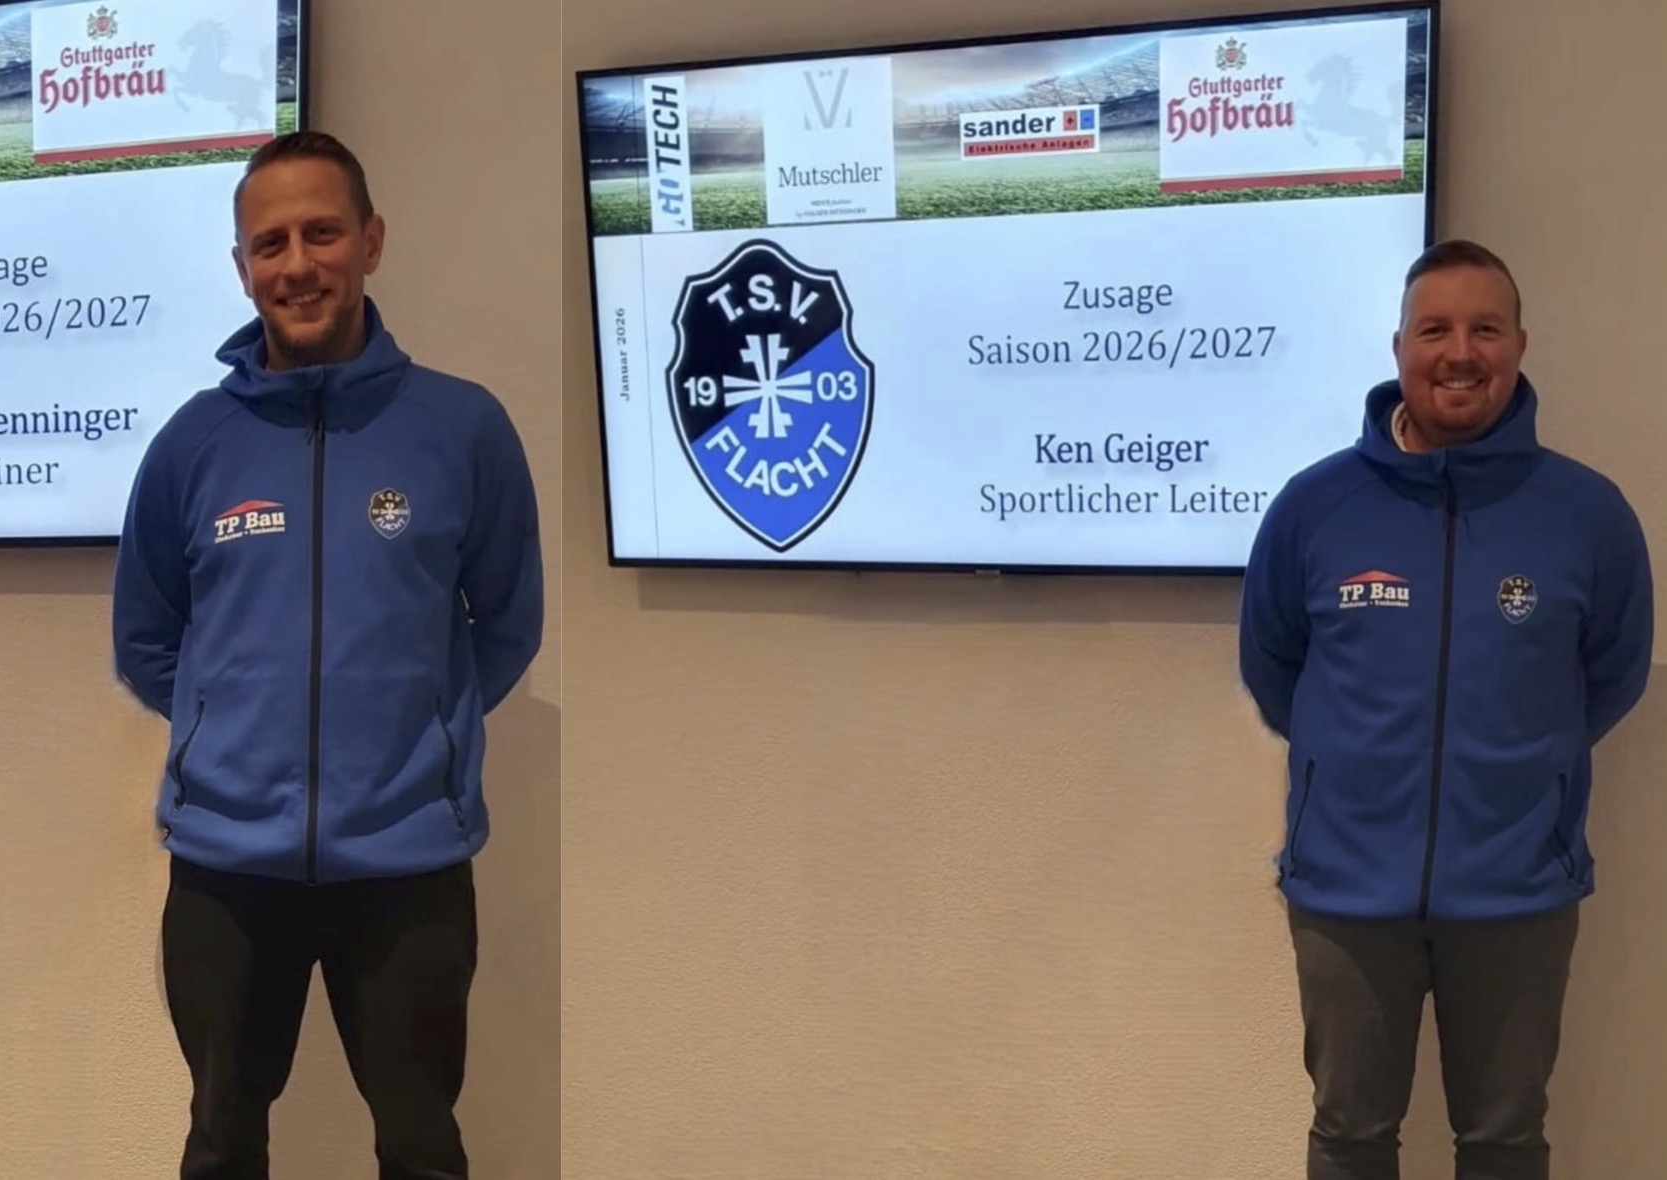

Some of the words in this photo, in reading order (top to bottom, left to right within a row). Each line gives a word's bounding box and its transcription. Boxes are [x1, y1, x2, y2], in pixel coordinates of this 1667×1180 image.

[60, 42, 155, 69] Stuttgarter
[39, 61, 165, 113] Hofbräu
[1188, 74, 1285, 98] Stuttgarter
[963, 113, 1055, 138] sander
[1166, 93, 1293, 142] Hofbräu
[968, 142, 1036, 154] Elektrische
[1042, 139, 1090, 149] Anlagen
[778, 163, 883, 188] Mutschler
[707, 274, 819, 324] T.S.V.
[1063, 281, 1173, 314] Zusage
[616, 308, 626, 345] 2026
[968, 335, 1072, 365] Saison
[1083, 325, 1276, 369] 2026/2027
[619, 350, 630, 401] Januar
[684, 376, 717, 406] 19
[816, 371, 858, 401] 03
[705, 422, 846, 497] FLACHT
[1034, 433, 1094, 463] Ken
[1104, 433, 1209, 472] Geiger
[980, 483, 1159, 521] Sportlicher
[1169, 483, 1268, 513] Leiter
[215, 516, 240, 536] TP
[245, 511, 285, 529] Bau
[1339, 584, 1364, 601] TP
[1370, 583, 1409, 600] Bau
